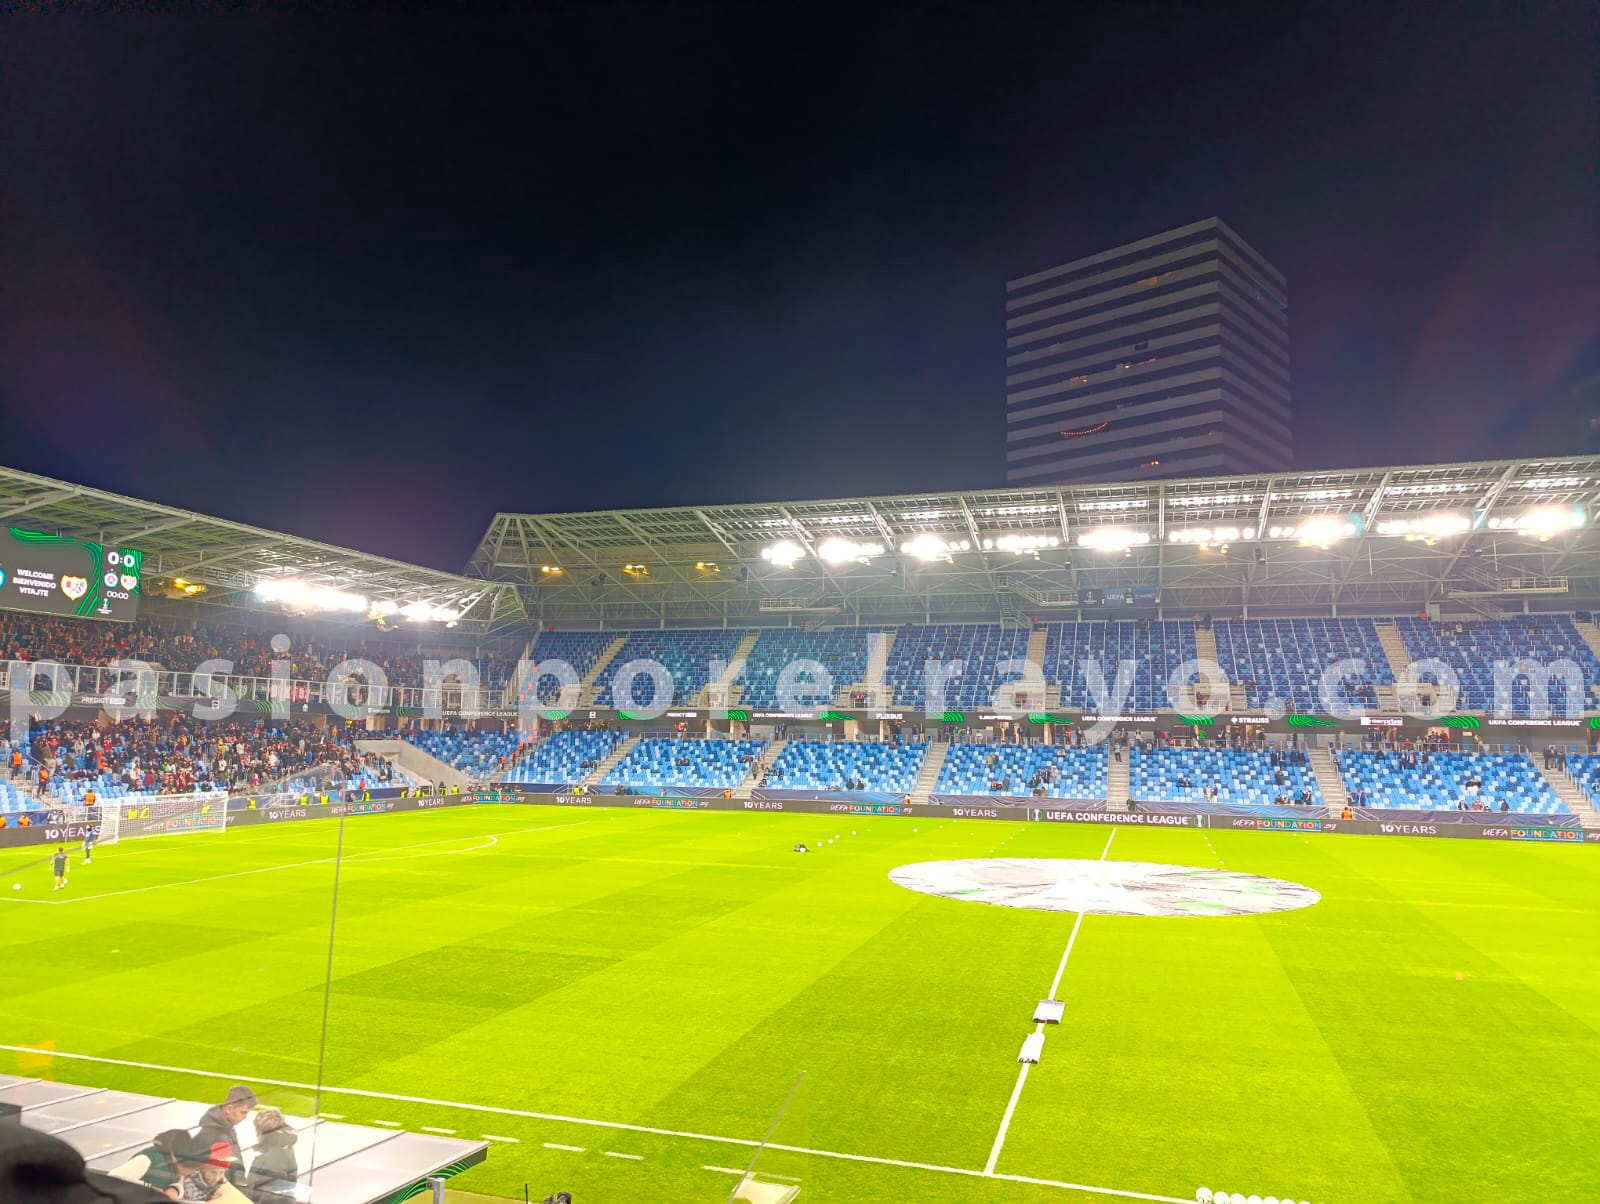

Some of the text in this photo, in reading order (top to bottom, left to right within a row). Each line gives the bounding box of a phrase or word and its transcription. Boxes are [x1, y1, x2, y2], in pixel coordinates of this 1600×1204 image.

[107, 551, 135, 567] 0:0
[17, 569, 54, 580] WELCOME
[13, 577, 56, 589] BIENVENIDO
[19, 586, 49, 597] VITAJTE
[107, 590, 129, 600] 00:00
[849, 805, 900, 813] FOUNDATION
[1046, 811, 1073, 821] UEFA
[1075, 812, 1144, 823] CONFERENCE
[1256, 819, 1321, 829] FOUNDATION
[44, 824, 102, 840] 10YEAS
[1482, 828, 1508, 836] UEFA
[1510, 829, 1584, 839] FOUNDATION
